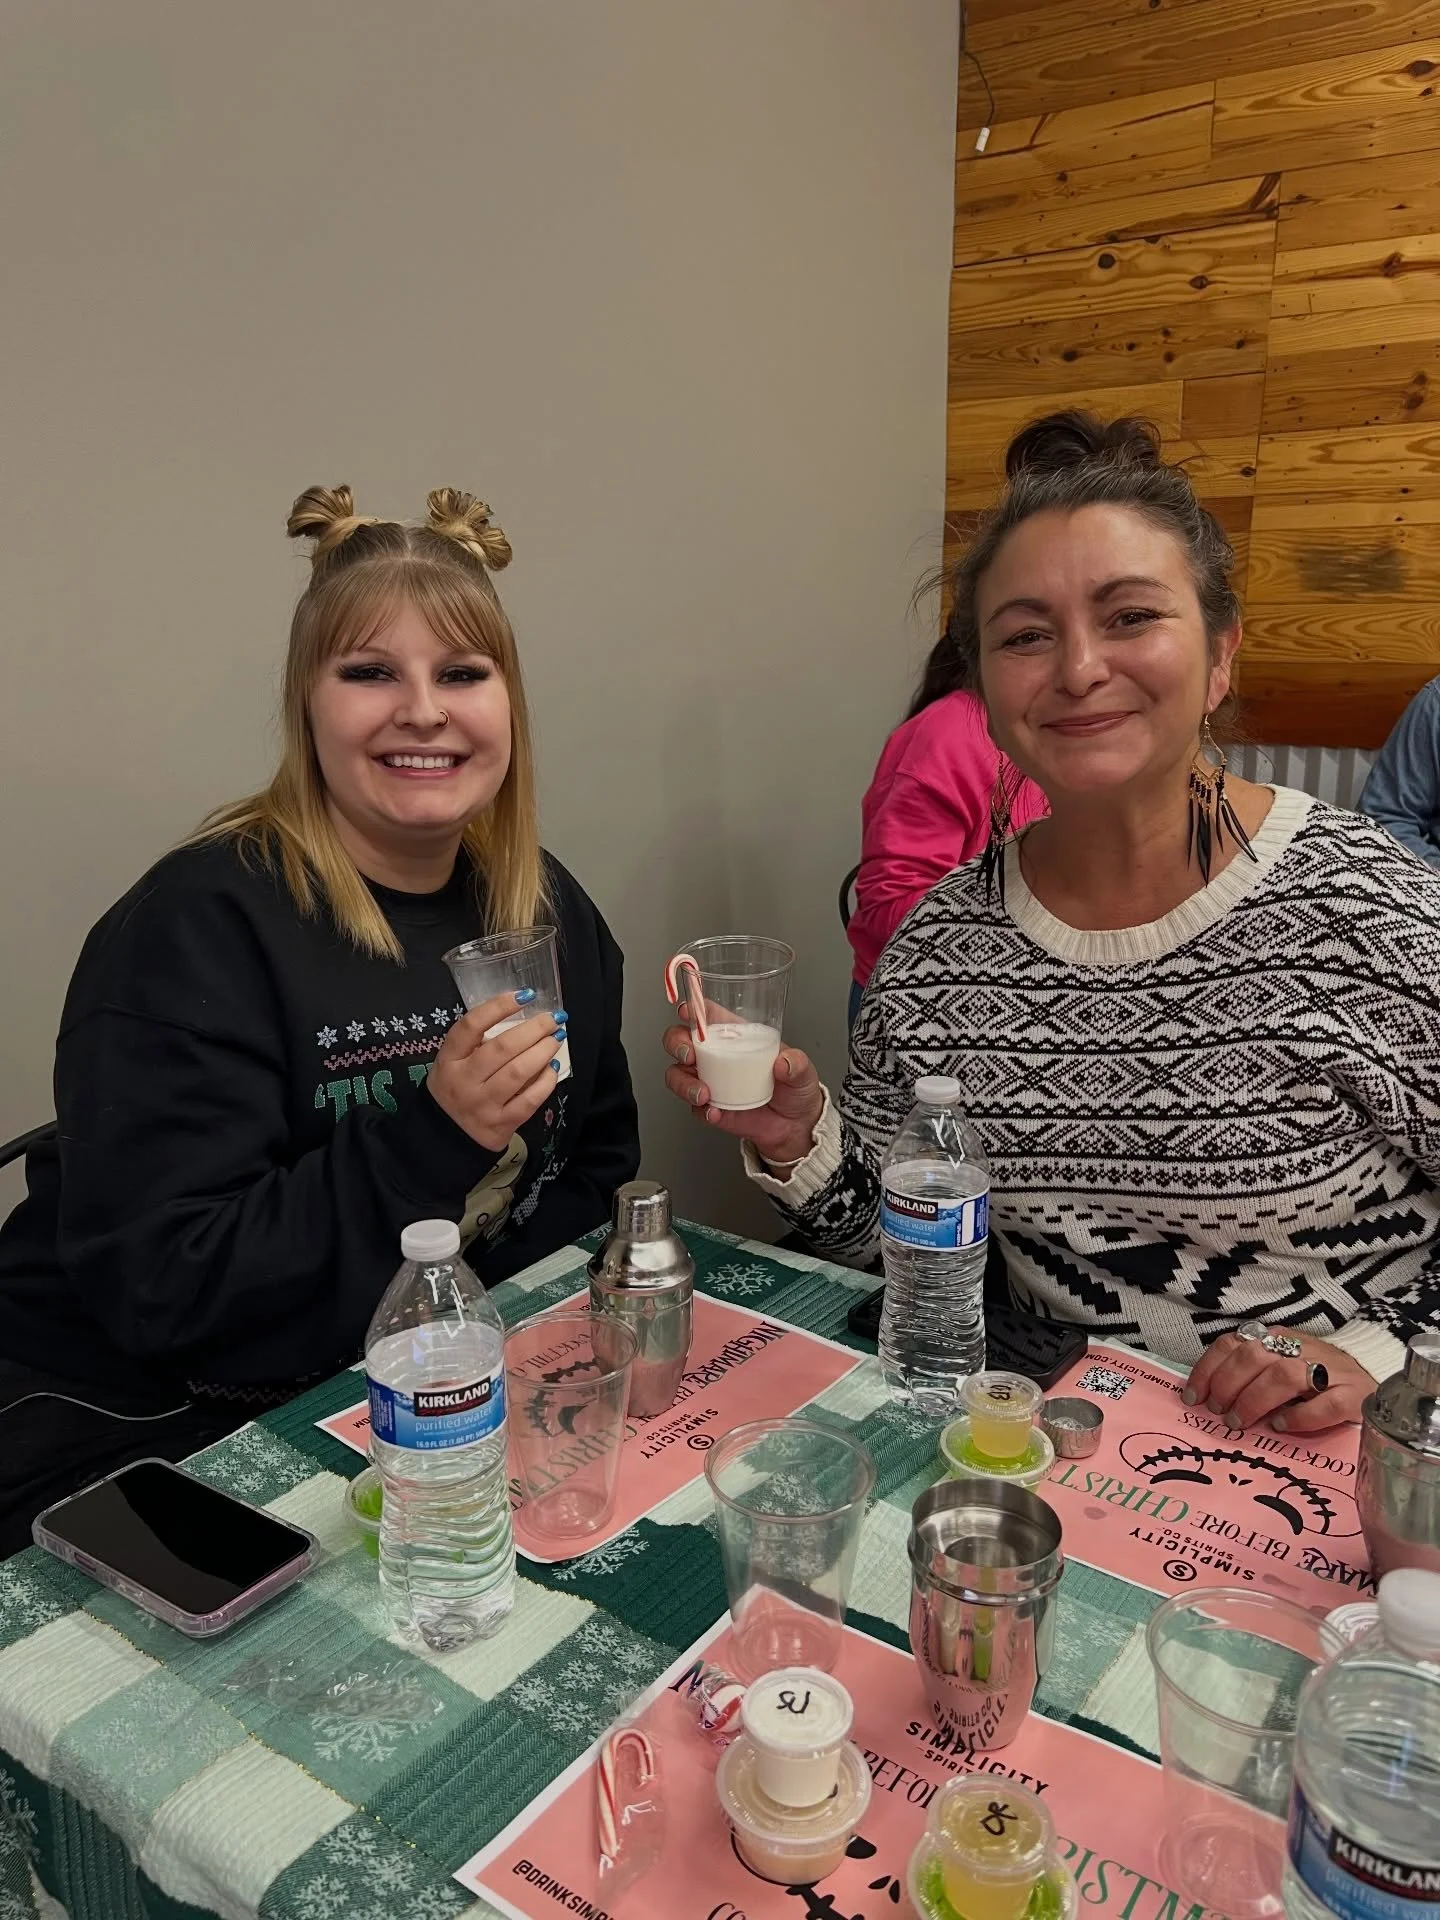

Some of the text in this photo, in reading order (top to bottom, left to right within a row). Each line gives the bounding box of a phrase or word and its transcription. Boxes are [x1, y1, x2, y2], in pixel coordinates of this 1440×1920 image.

[886, 1192, 936, 1214] KIRKLAND
[911, 1219, 937, 1232] water
[682, 1321, 789, 1389] NIGHTMARE
[1085, 1353, 1184, 1395] NKSIMPLICITY.COM
[418, 1382, 490, 1408] KIRKLAND
[415, 1416, 461, 1433] purified
[463, 1406, 493, 1425] water
[640, 1408, 719, 1460] SIMPLICITY
[662, 1413, 692, 1434] SPIRITS
[1251, 1432, 1356, 1477] COCKTAIL
[1047, 1464, 1189, 1523] CHRIST
[1129, 1527, 1256, 1581] SIMPLICITY
[1184, 1536, 1234, 1560] SPIRITS
[1190, 1510, 1291, 1561] BEFORE
[906, 1721, 1049, 1796] SIMPLICITY
[1336, 1837, 1440, 1891] KIRKLAN
